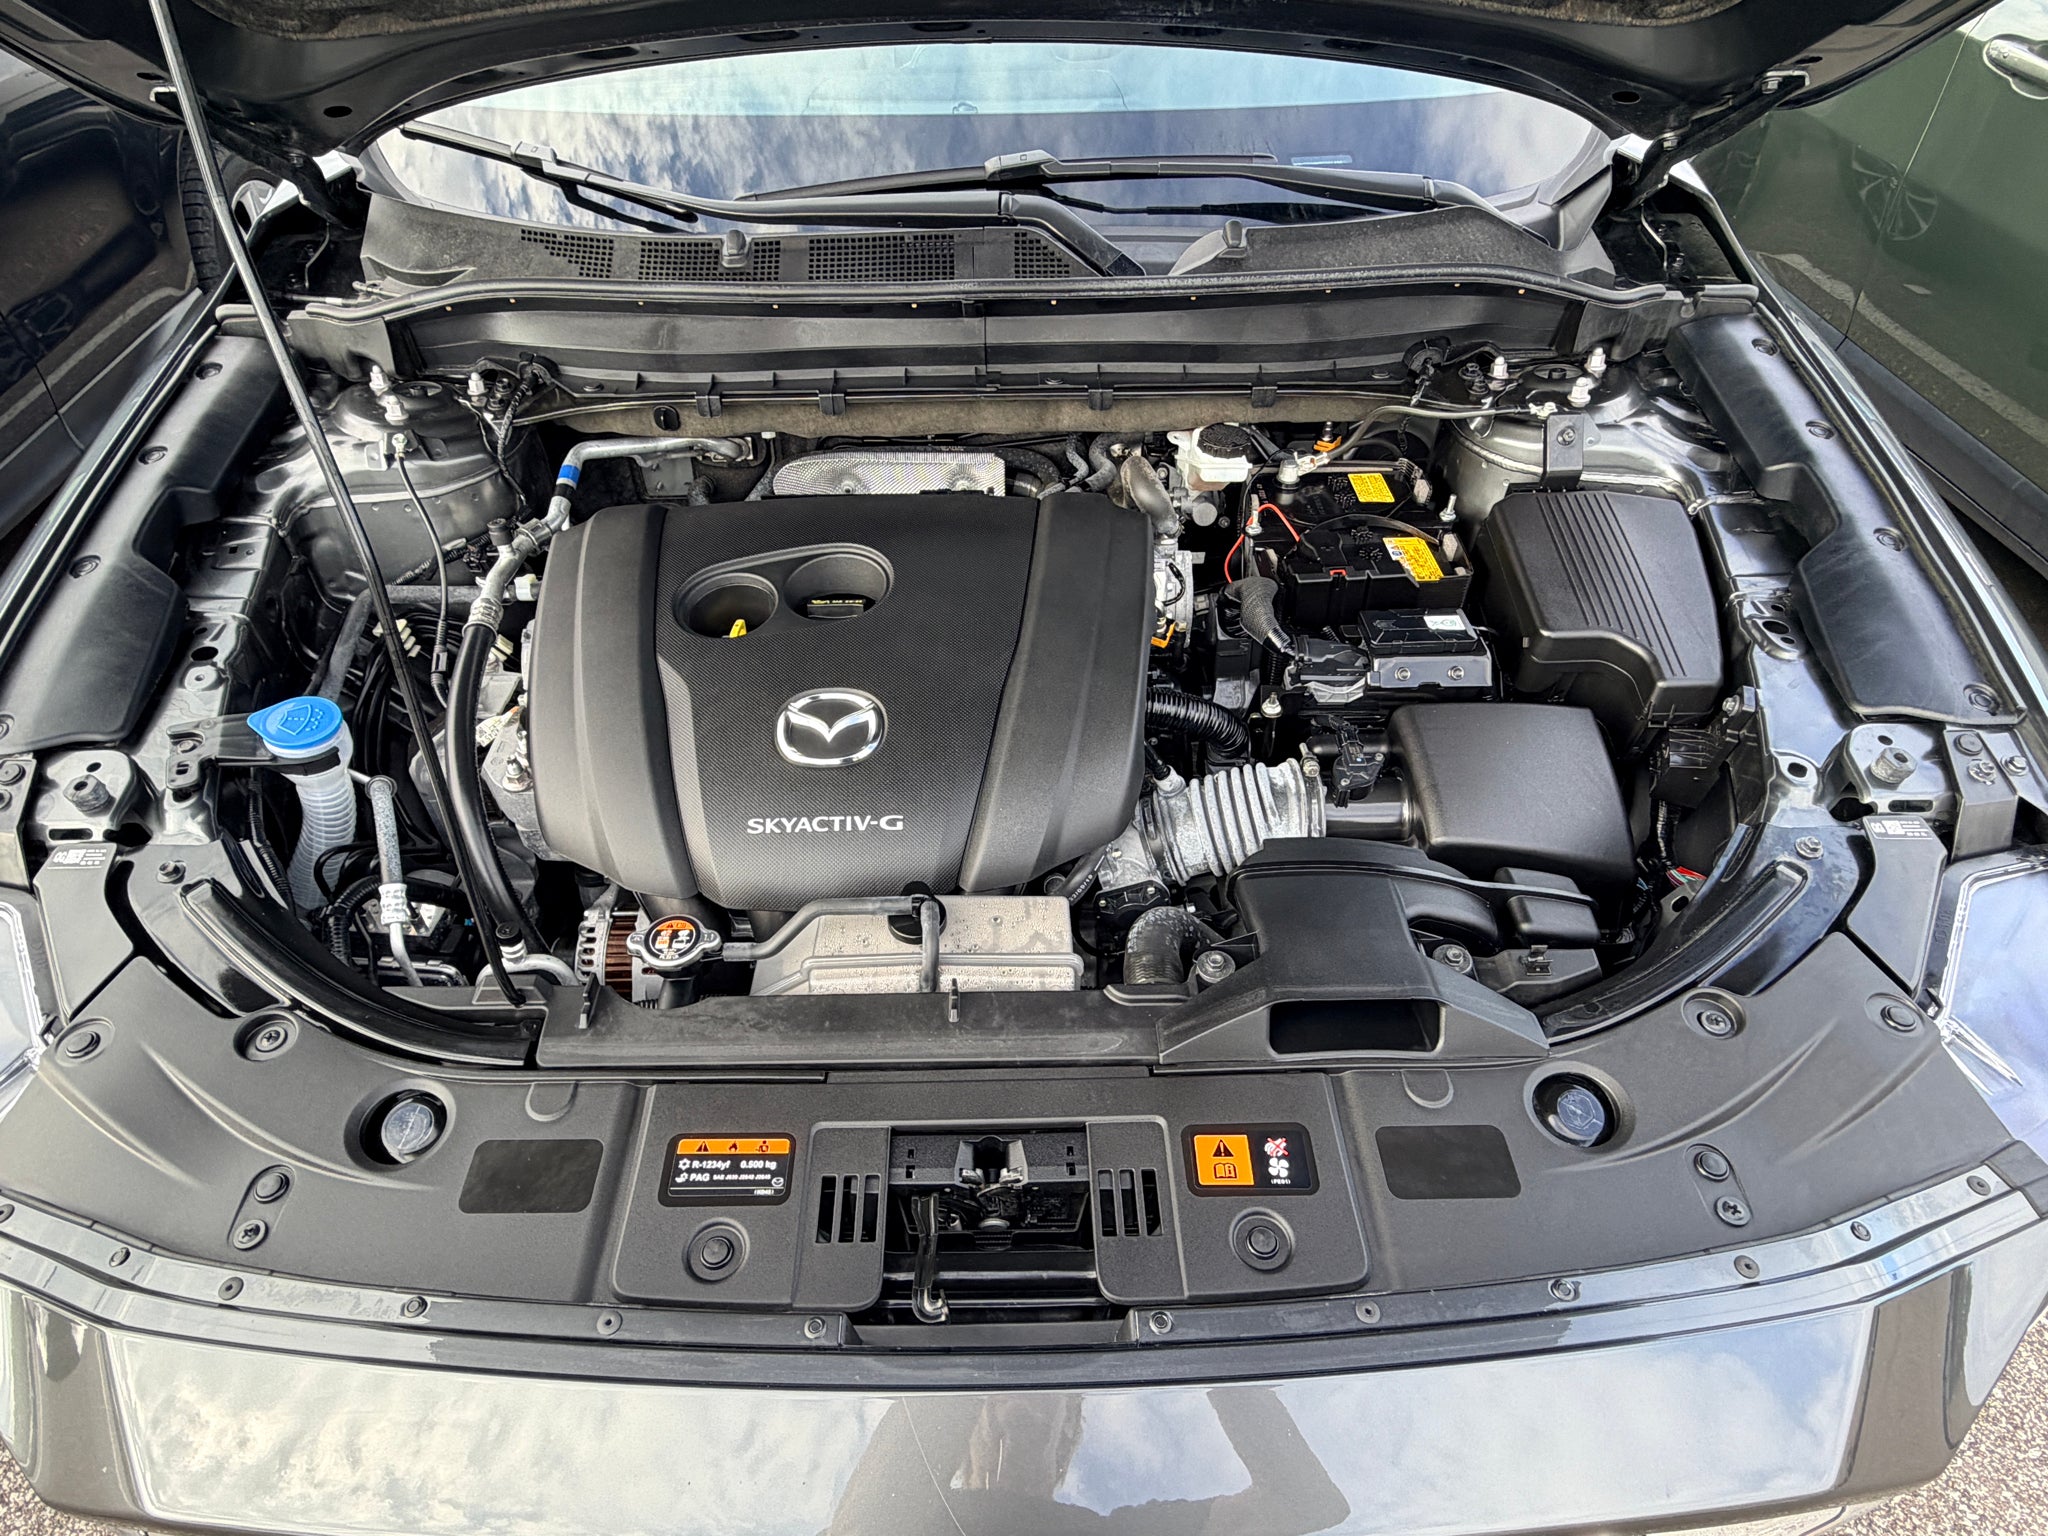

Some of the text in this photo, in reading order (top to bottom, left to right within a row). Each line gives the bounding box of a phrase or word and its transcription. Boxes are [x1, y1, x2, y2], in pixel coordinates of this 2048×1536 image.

[746, 815, 904, 835] SKYACTIV-G
[692, 1160, 731, 1171] R-1234yf
[765, 1160, 777, 1170] kg
[689, 1173, 710, 1182] PAG
